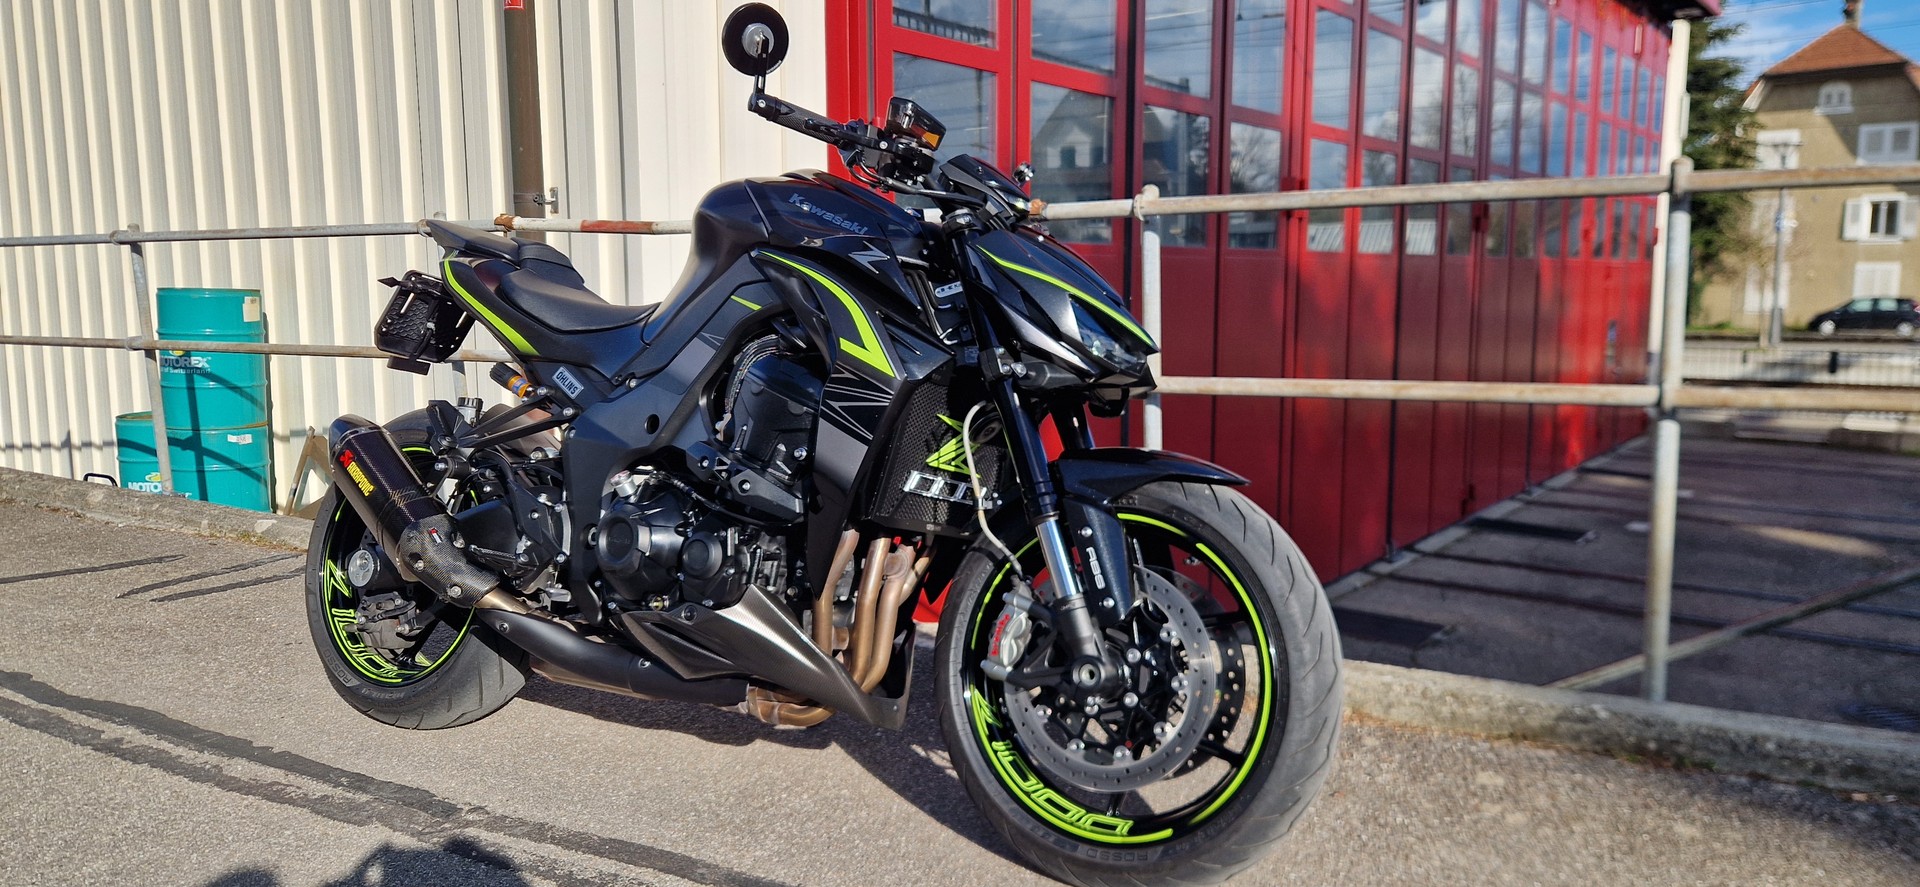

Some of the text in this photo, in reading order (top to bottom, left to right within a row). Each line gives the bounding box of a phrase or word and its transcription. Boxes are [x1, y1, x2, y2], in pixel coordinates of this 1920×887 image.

[788, 193, 869, 235] Kawasaki
[160, 355, 210, 368] OTOREX
[127, 481, 164, 493] MOTO
[1085, 546, 1106, 590] ABS
